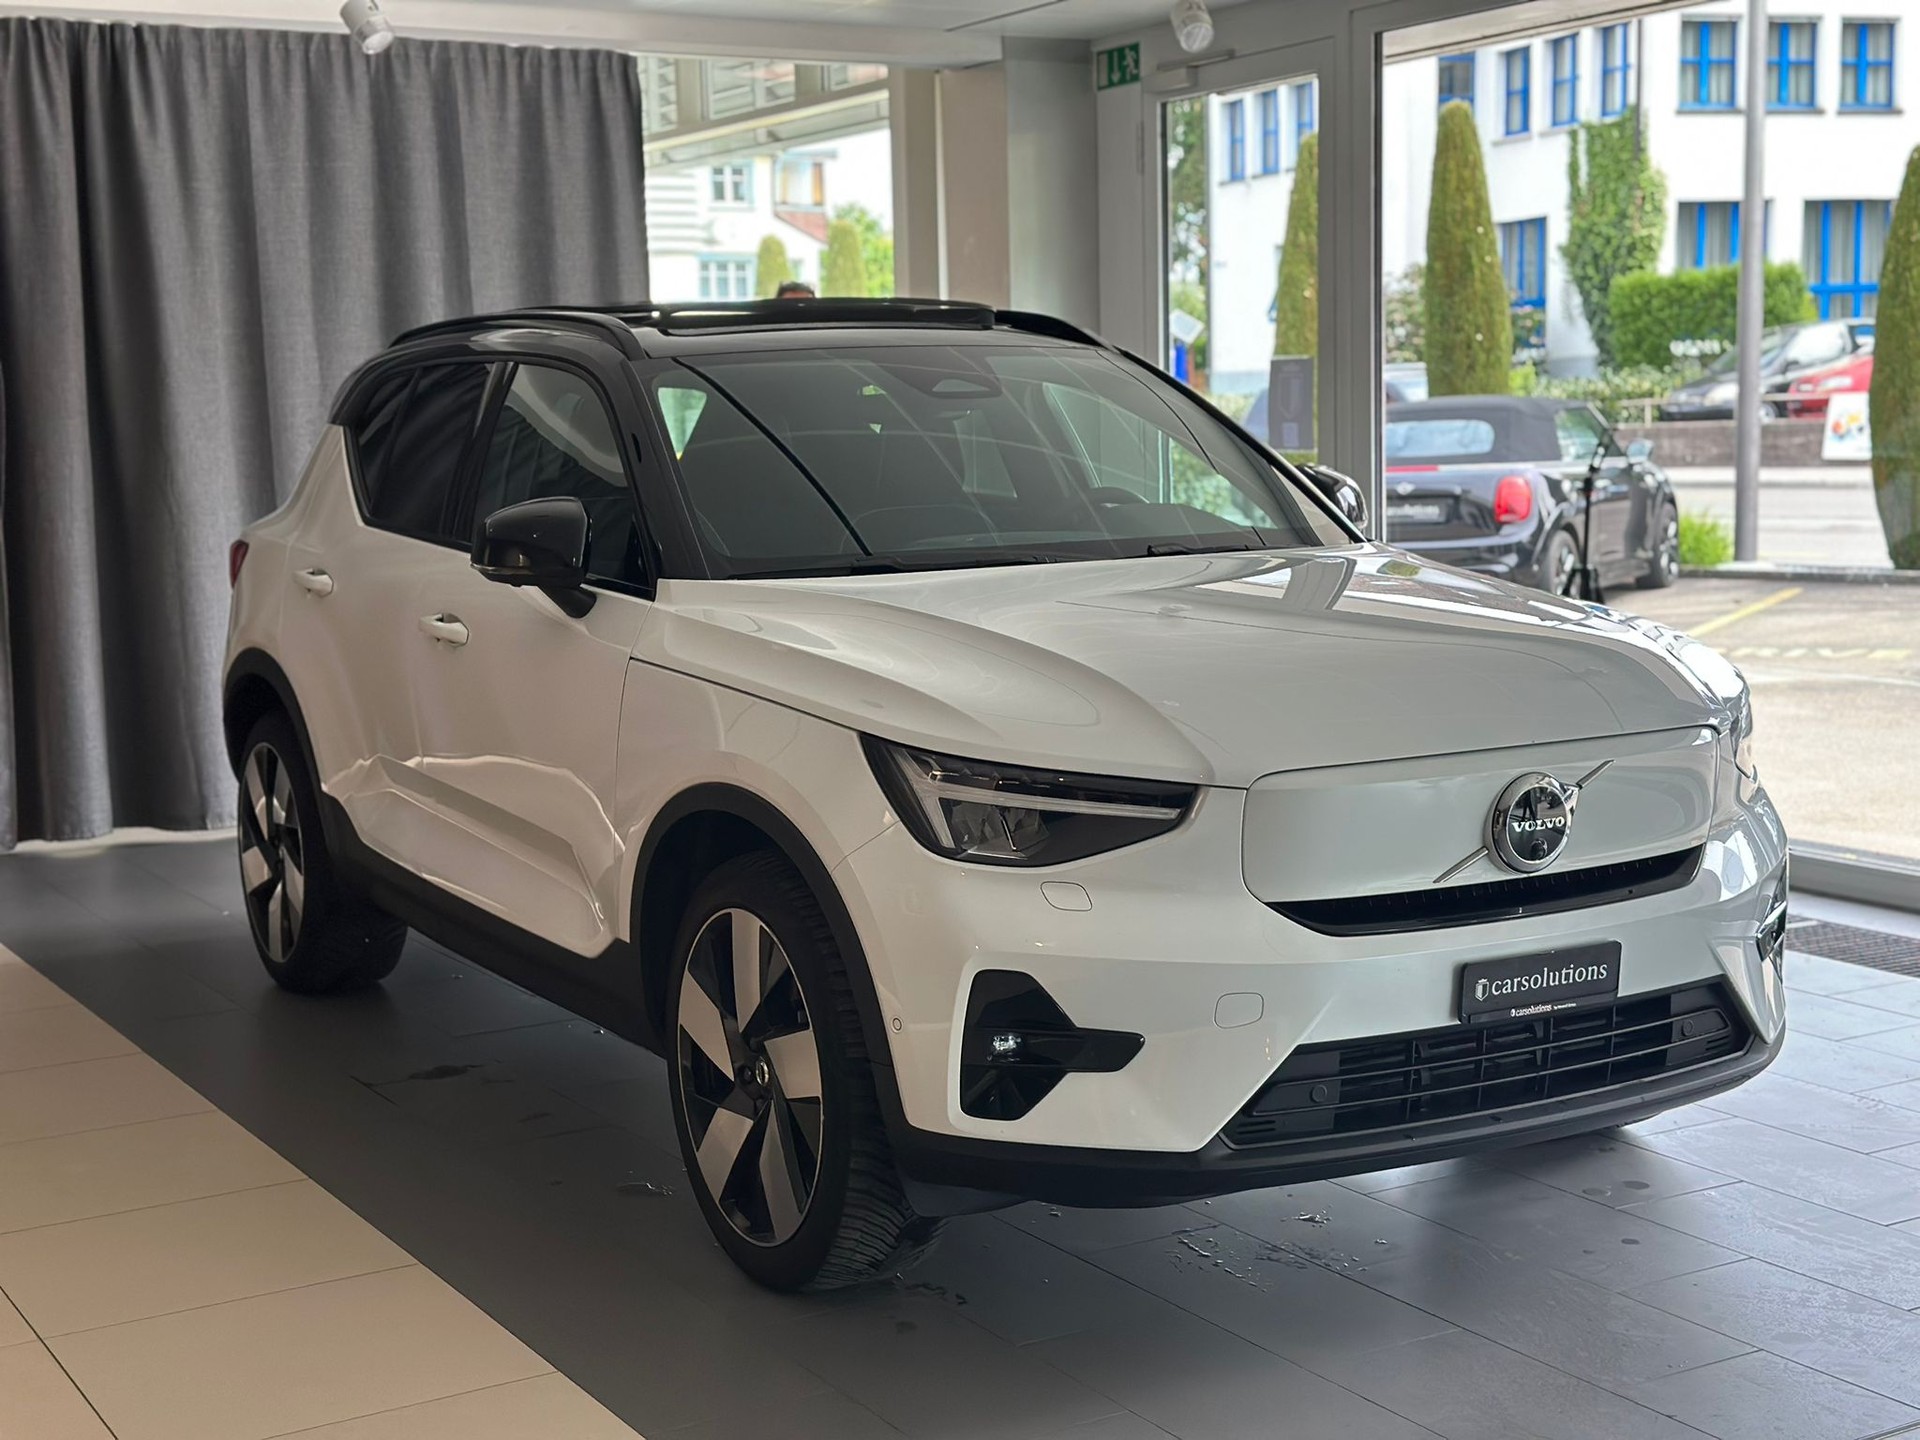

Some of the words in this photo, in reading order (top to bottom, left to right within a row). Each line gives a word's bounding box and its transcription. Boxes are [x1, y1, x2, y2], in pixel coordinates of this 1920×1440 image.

[1511, 816, 1565, 832] VOLVO
[1491, 963, 1608, 996] carsolutions
[1515, 1004, 1552, 1017] carsolutions
